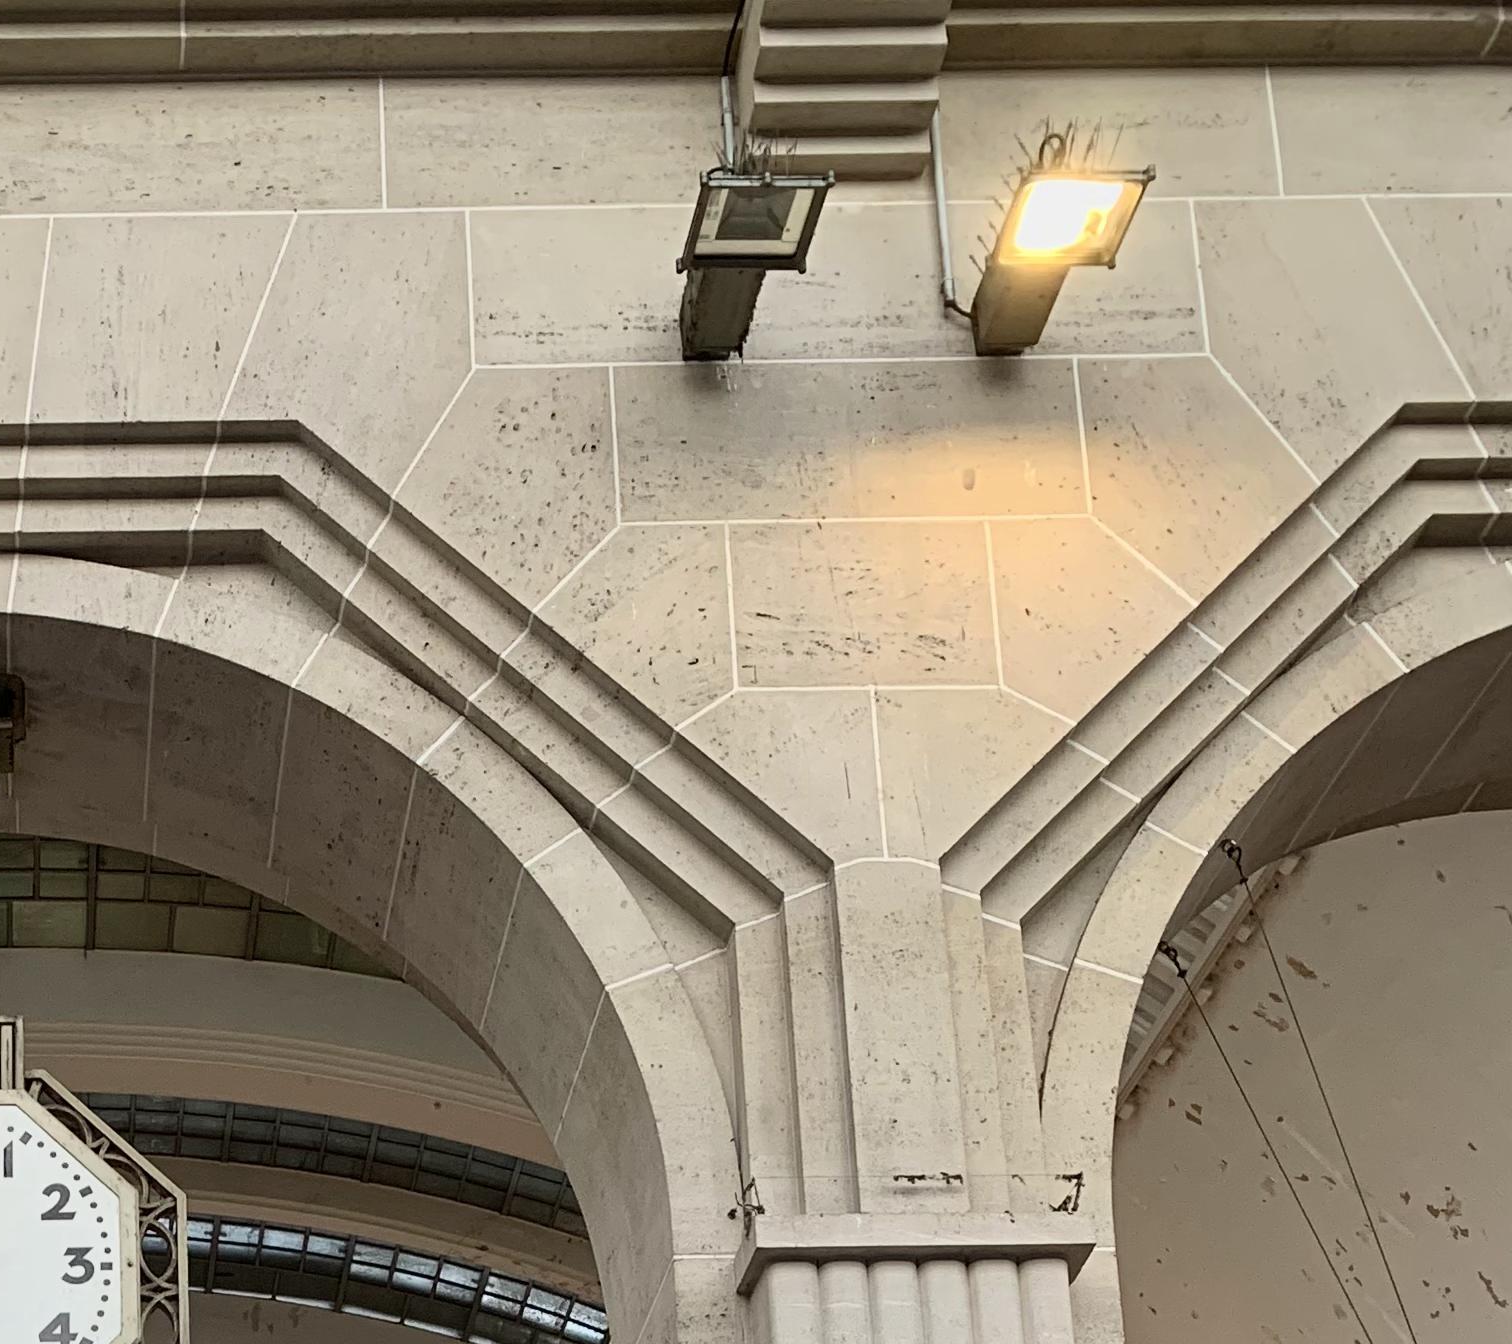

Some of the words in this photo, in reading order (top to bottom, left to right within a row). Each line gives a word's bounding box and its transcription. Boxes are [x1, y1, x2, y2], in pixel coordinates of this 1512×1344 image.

[3, 1140, 14, 1178] 1
[40, 1183, 77, 1221] 2
[61, 1246, 95, 1285] 3
